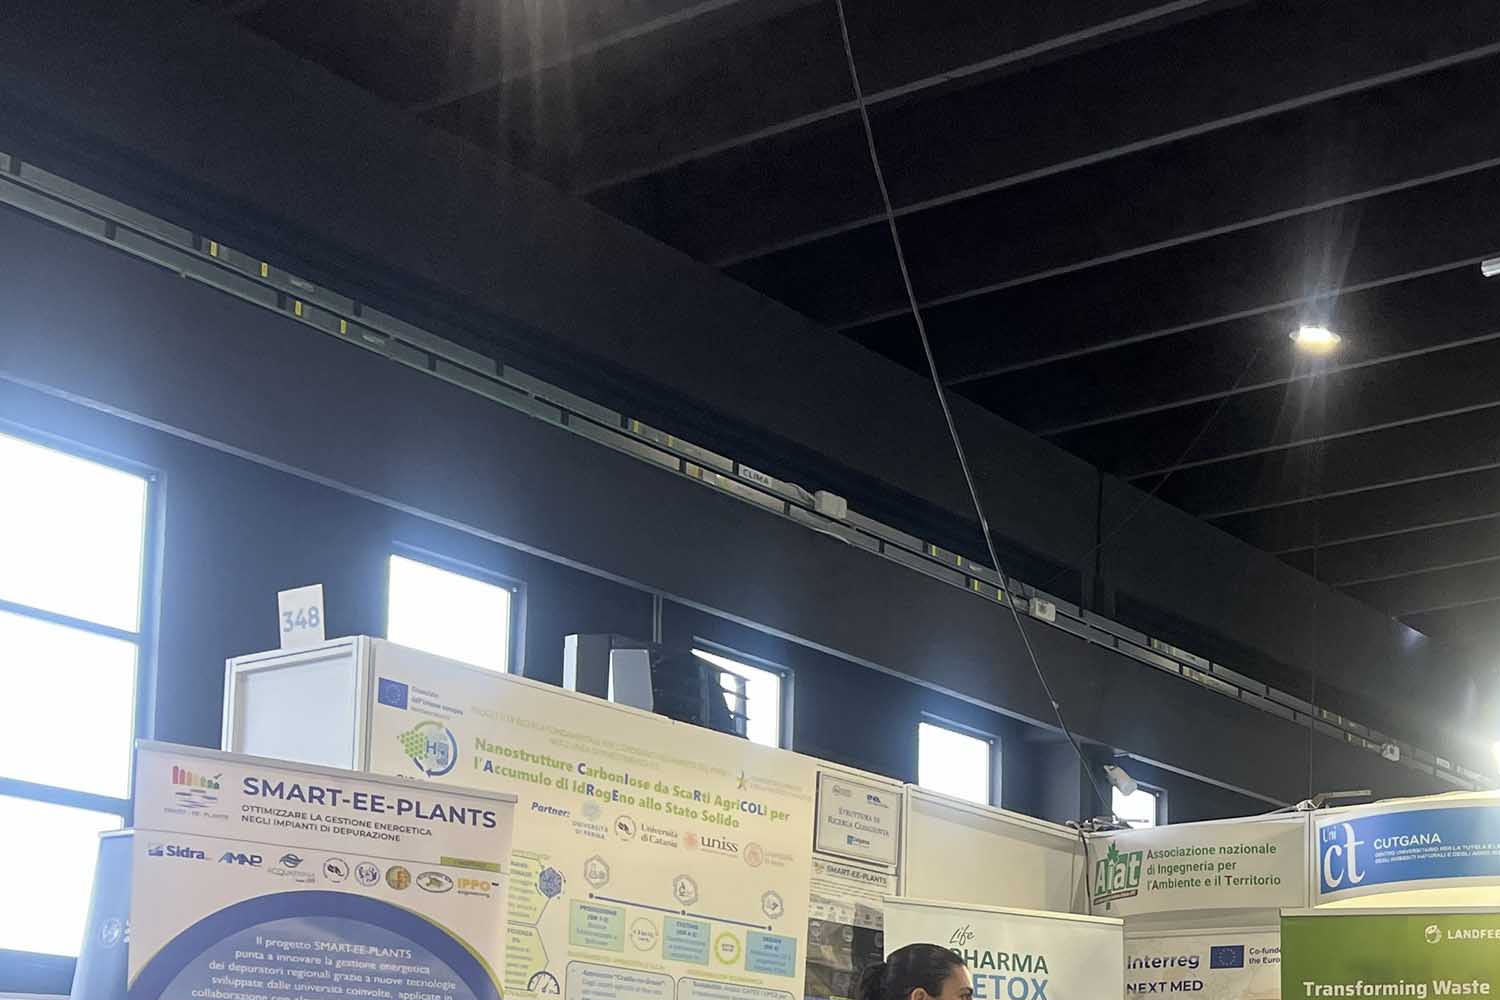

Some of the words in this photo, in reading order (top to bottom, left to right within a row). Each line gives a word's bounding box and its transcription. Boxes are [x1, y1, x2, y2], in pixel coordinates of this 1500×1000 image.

[283, 607, 320, 632] 348
[475, 738, 573, 771] Nanostrutture
[578, 762, 650, 788] CarbonIose
[654, 779, 669, 793] da
[770, 808, 790, 820] per
[475, 757, 552, 785] l'Accumulo
[556, 775, 568, 789] di
[639, 794, 662, 809] allo
[665, 799, 698, 817] Stato
[702, 807, 739, 827] Solido
[243, 777, 496, 828] SMART-EE-PLANTS
[531, 802, 570, 818] Partner:
[242, 805, 306, 819] OTTIMIZZARE
[309, 813, 322, 821] LA
[325, 815, 371, 827] GESTIONE
[374, 821, 432, 835] ENERGETICA
[242, 815, 270, 825] NEGLI
[274, 819, 318, 831] IMPIANTI
[321, 825, 329, 833] DI
[333, 826, 400, 841] DEPURAZIONE
[701, 837, 738, 852] uniss
[1374, 833, 1441, 849] CUTGANA
[1147, 848, 1215, 859] Associazione
[1219, 845, 1276, 855] nazionale
[1324, 823, 1366, 888] ct
[1147, 865, 1155, 874] di
[1158, 862, 1213, 876] Ingegneria
[1218, 863, 1236, 873] per
[1148, 878, 1201, 890] l'Ambiente
[1215, 877, 1221, 887] il
[1224, 875, 1280, 886] Territorio
[950, 924, 975, 946] Life
[1128, 955, 1199, 969] Interreg
[1127, 982, 1167, 994] NEXT
[1171, 980, 1203, 991] MED
[1303, 980, 1427, 998] Transforming
[1433, 980, 1490, 995] Waste
